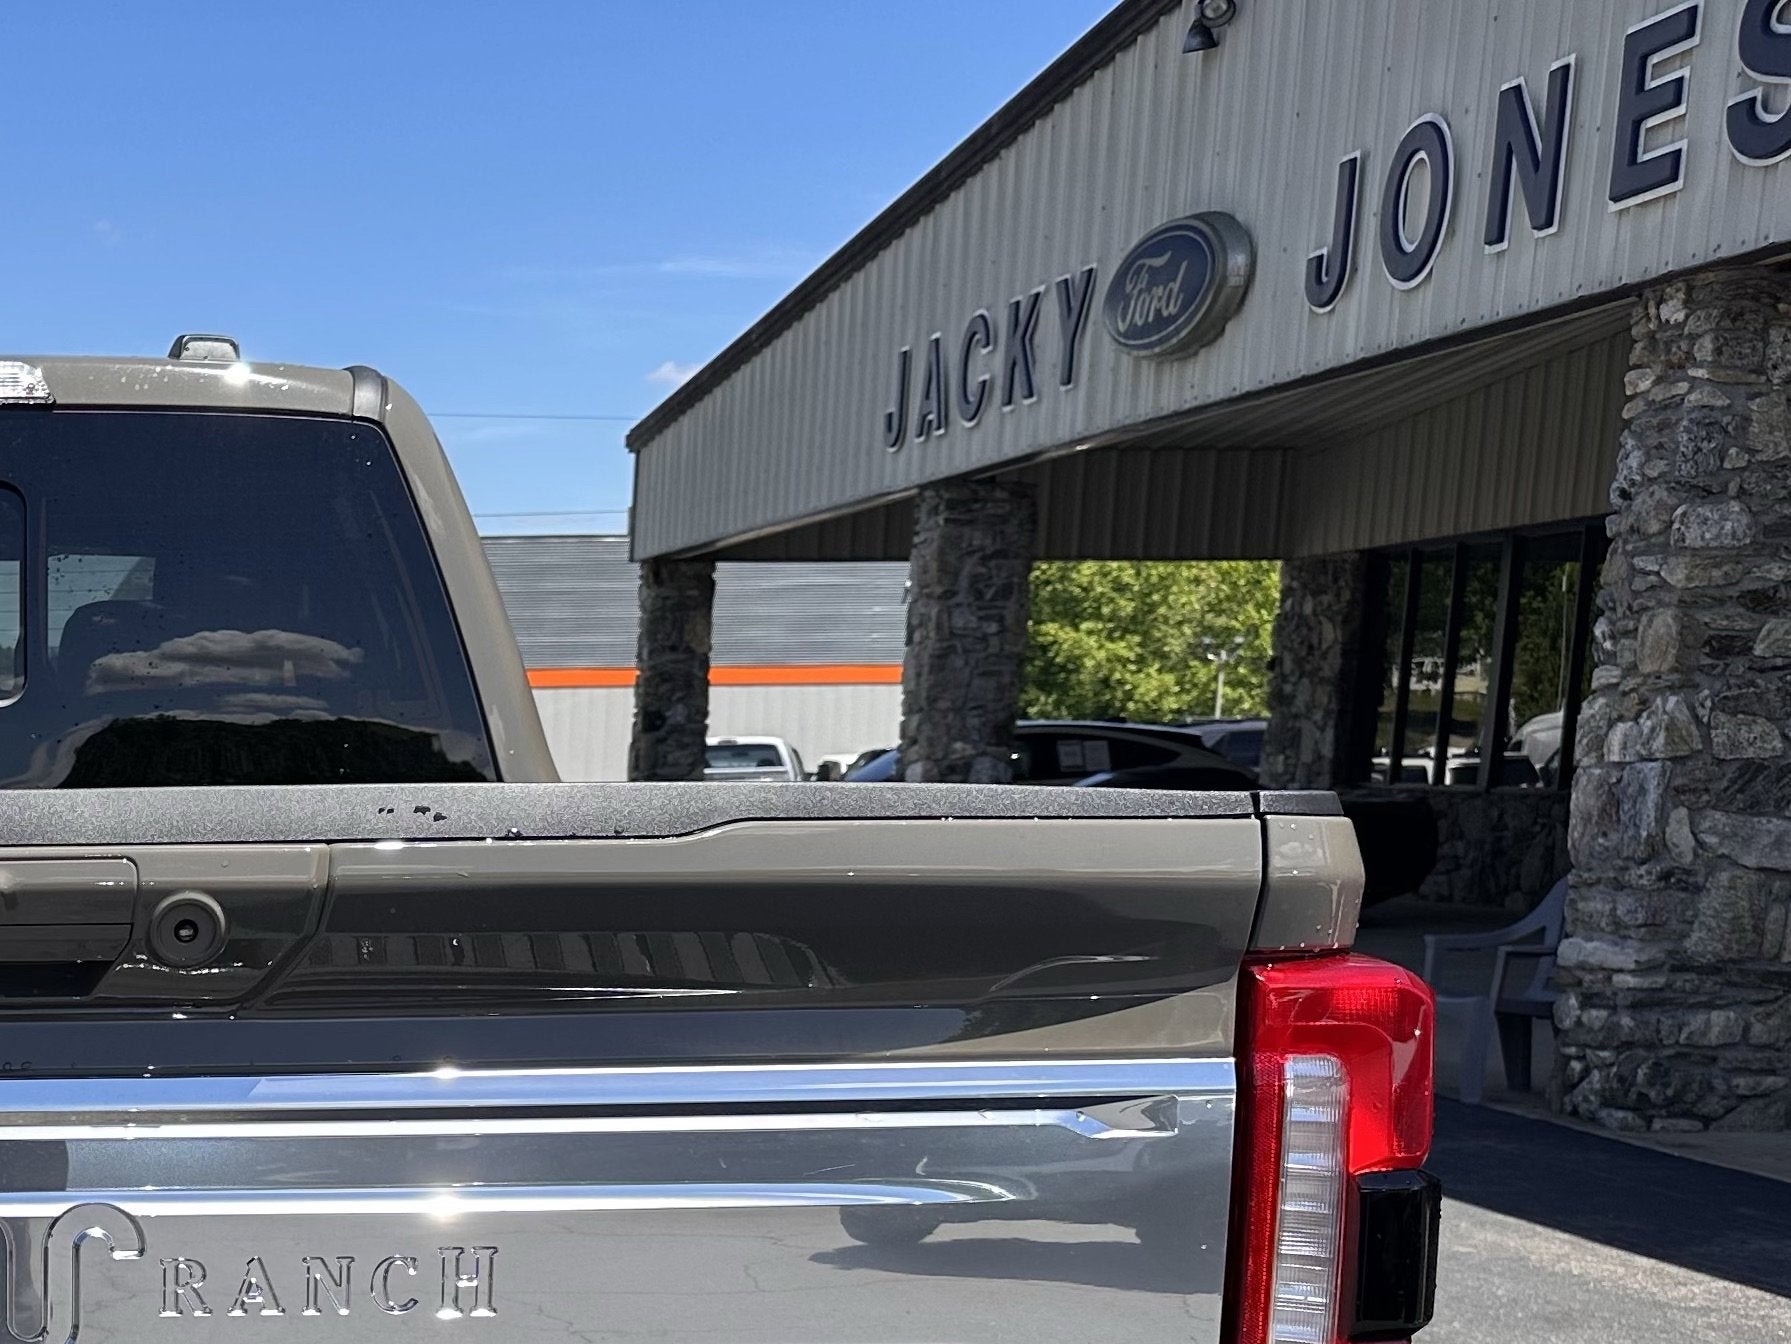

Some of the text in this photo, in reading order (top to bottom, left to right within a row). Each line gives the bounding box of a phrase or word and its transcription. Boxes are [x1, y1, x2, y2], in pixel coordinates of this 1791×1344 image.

[883, 0, 1791, 453] JACKY JONES
[1115, 250, 1188, 331] Ford
[158, 1245, 499, 1319] RANCH
